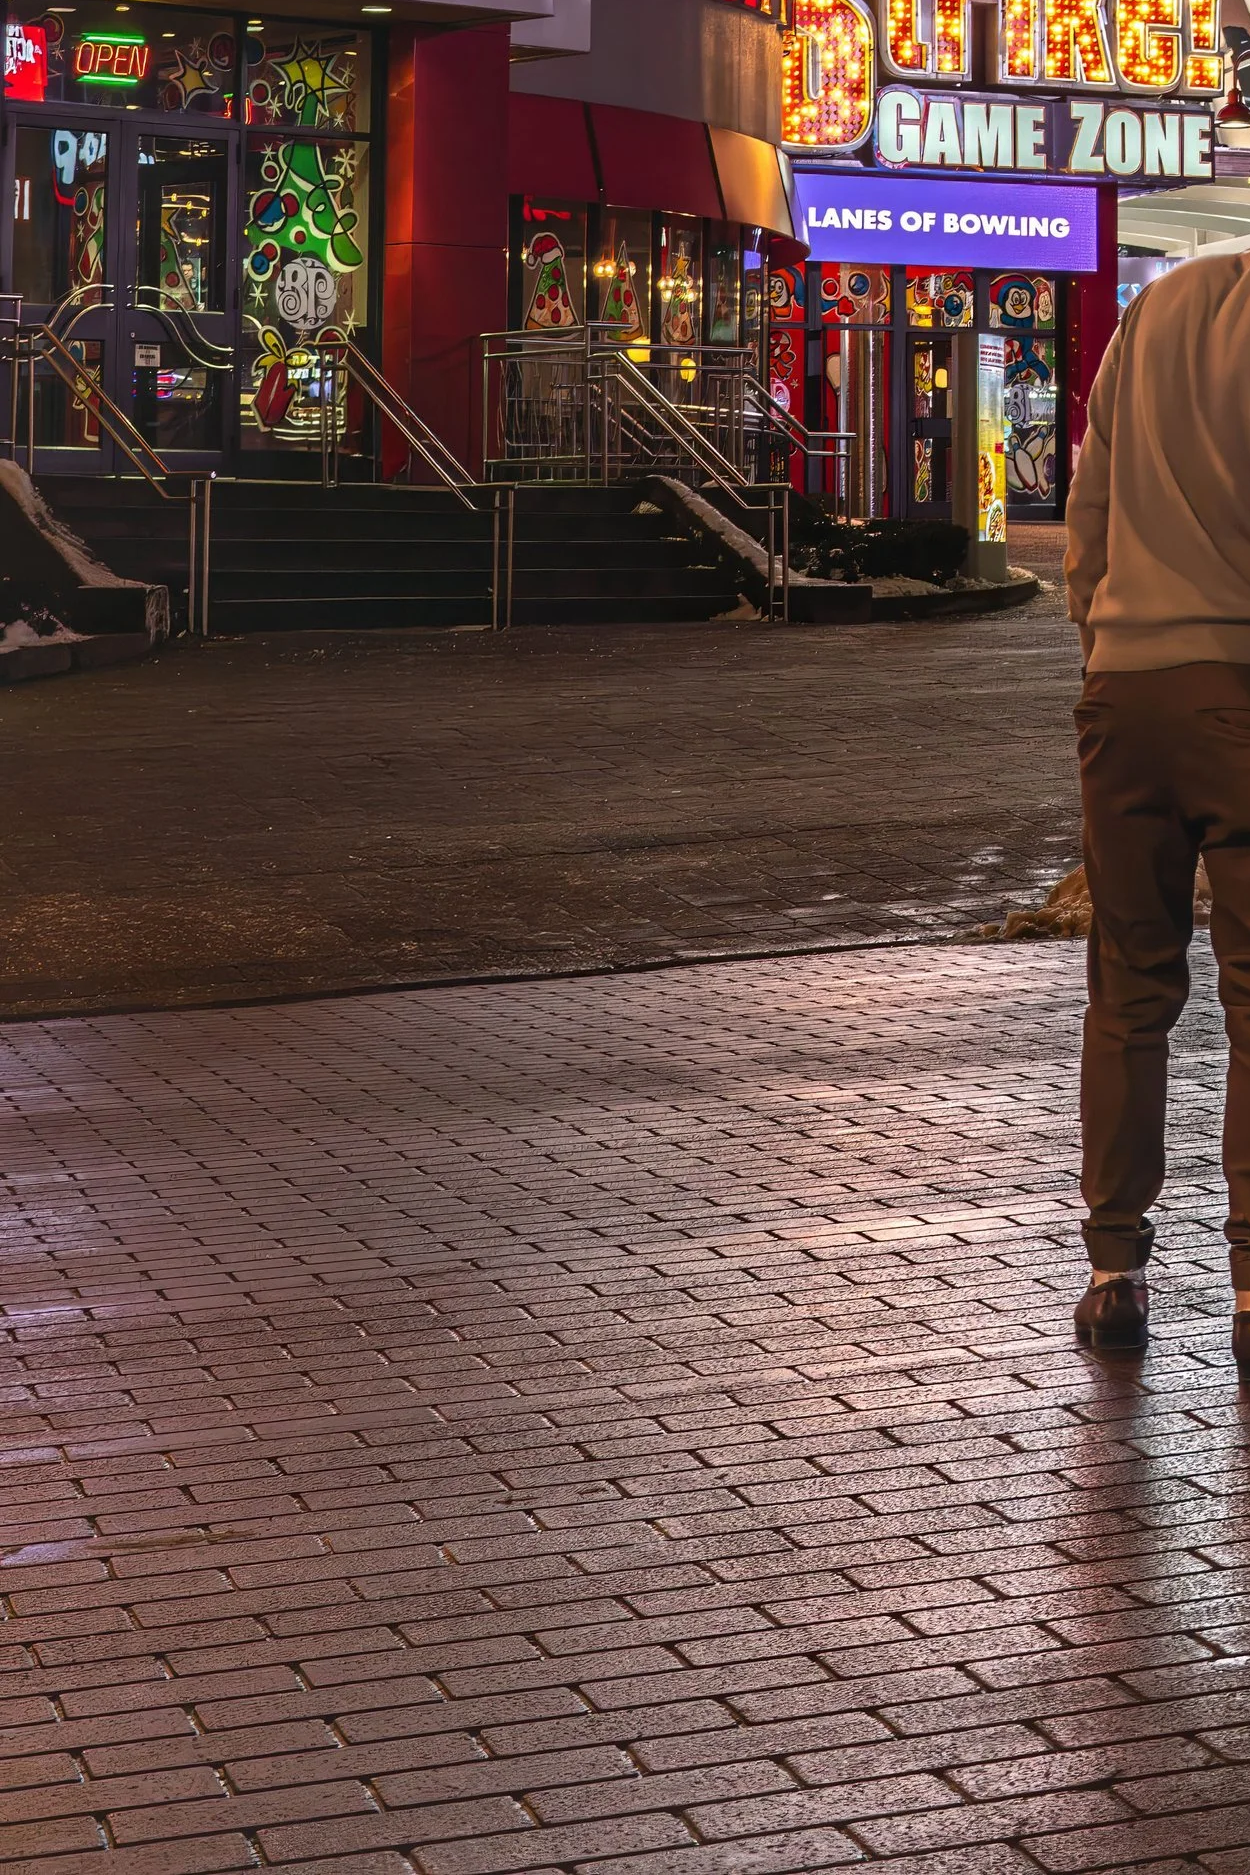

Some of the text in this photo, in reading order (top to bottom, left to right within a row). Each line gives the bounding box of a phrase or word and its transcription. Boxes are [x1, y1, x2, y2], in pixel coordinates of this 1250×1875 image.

[76, 41, 149, 78] OPEN
[877, 90, 1215, 178] GAME ZONE
[807, 206, 1071, 239] LANES OF BOWLING
